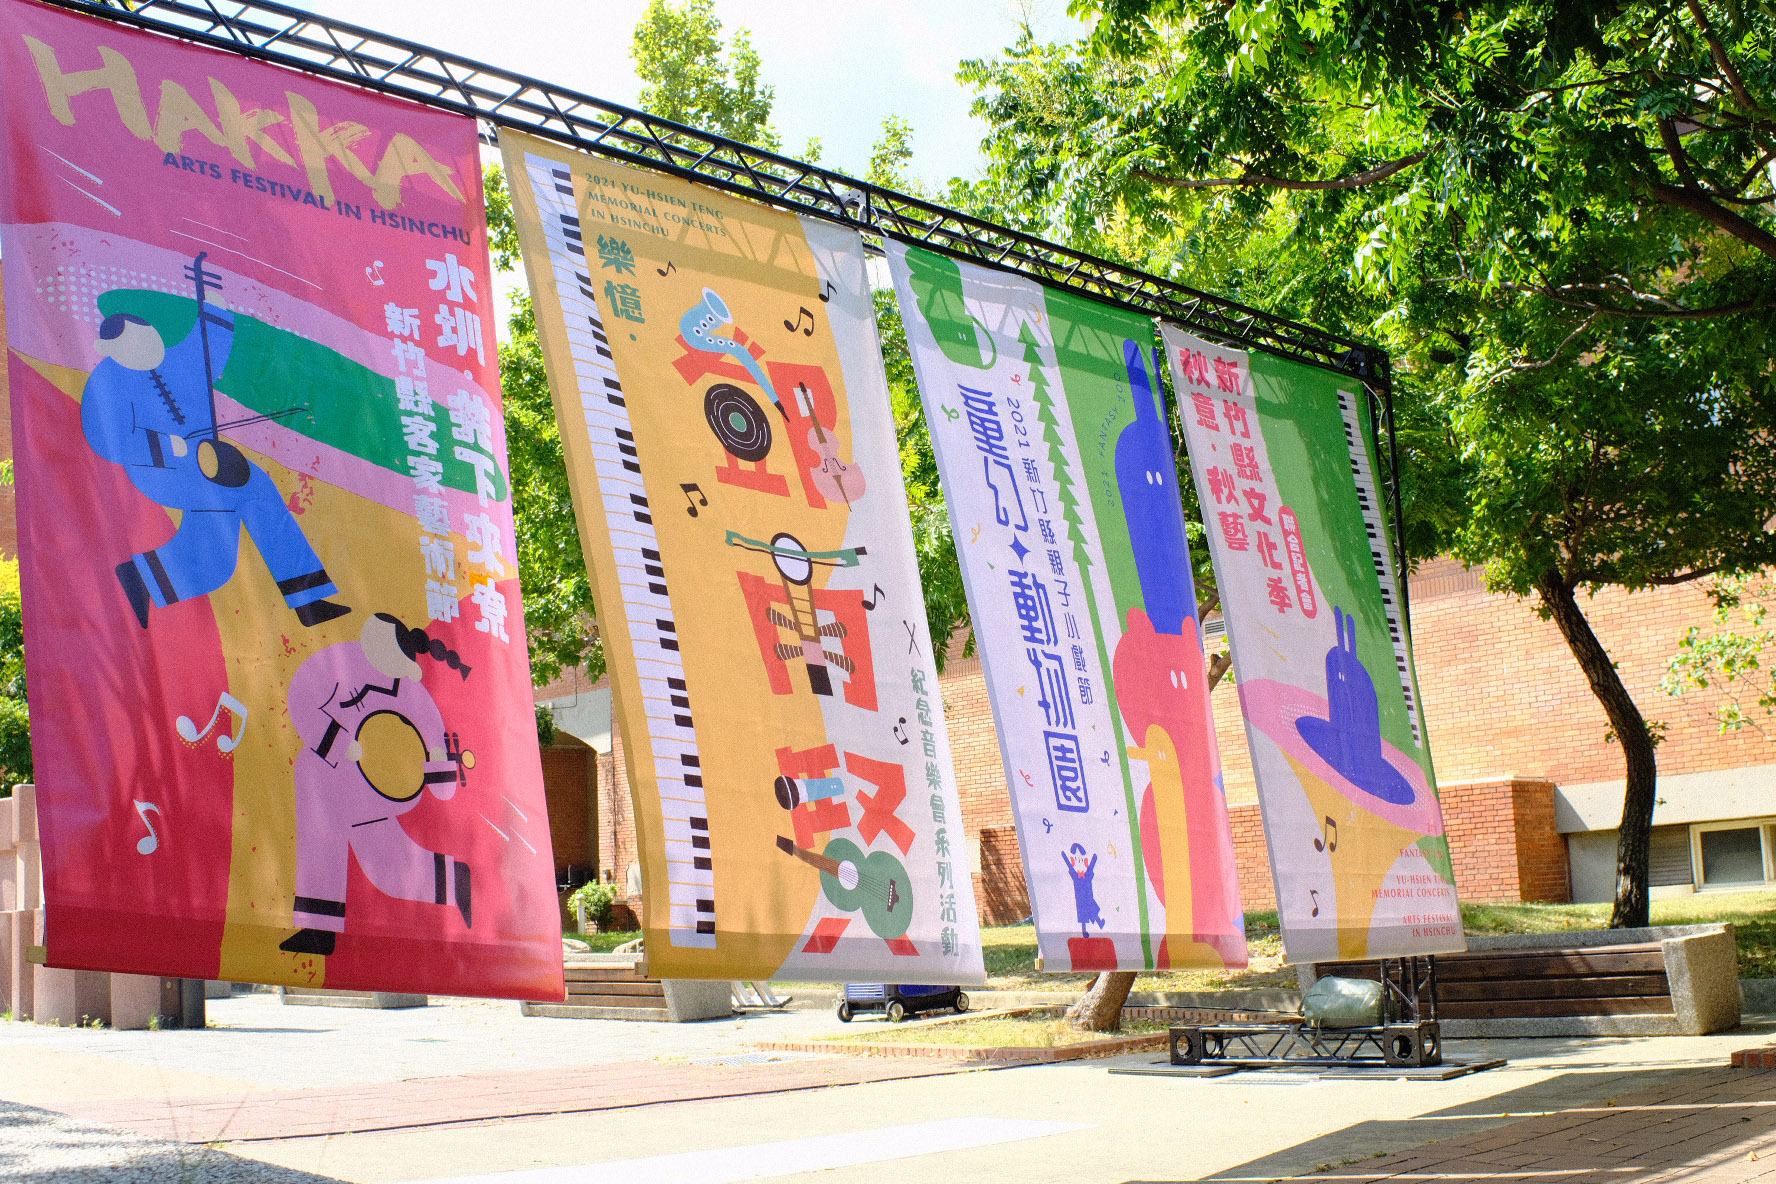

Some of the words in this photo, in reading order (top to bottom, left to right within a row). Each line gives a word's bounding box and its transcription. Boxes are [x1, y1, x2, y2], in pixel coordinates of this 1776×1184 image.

[22, 34, 466, 209] HAKKA
[162, 152, 222, 180] ARTS
[231, 165, 331, 212] FESTIVAL
[337, 200, 362, 221] IN
[370, 207, 472, 246] HSINCHU
[585, 172, 616, 189] 2021
[621, 182, 687, 208] YU-HSIEN
[690, 201, 724, 220] TENG
[588, 191, 659, 218] MEMORIAL
[663, 211, 727, 237] CONCERTS
[591, 208, 606, 219] IN
[610, 213, 669, 237] HSINCHU
[1007, 396, 1031, 448] 2021
[1098, 406, 1119, 457] FANTASY
[384, 302, 460, 623] 新竹縣客家藝術節
[1214, 355, 1293, 614] 新竹縣文化季
[1371, 888, 1413, 898] MEMORIAL
[1416, 887, 1450, 897] CONCERTS
[1396, 874, 1432, 885] YU-HSIEN
[1402, 914, 1421, 924] ARTS
[1423, 913, 1454, 924] FESTIVAL
[1412, 927, 1421, 937] IN
[1423, 926, 1457, 937] HSINCHU
